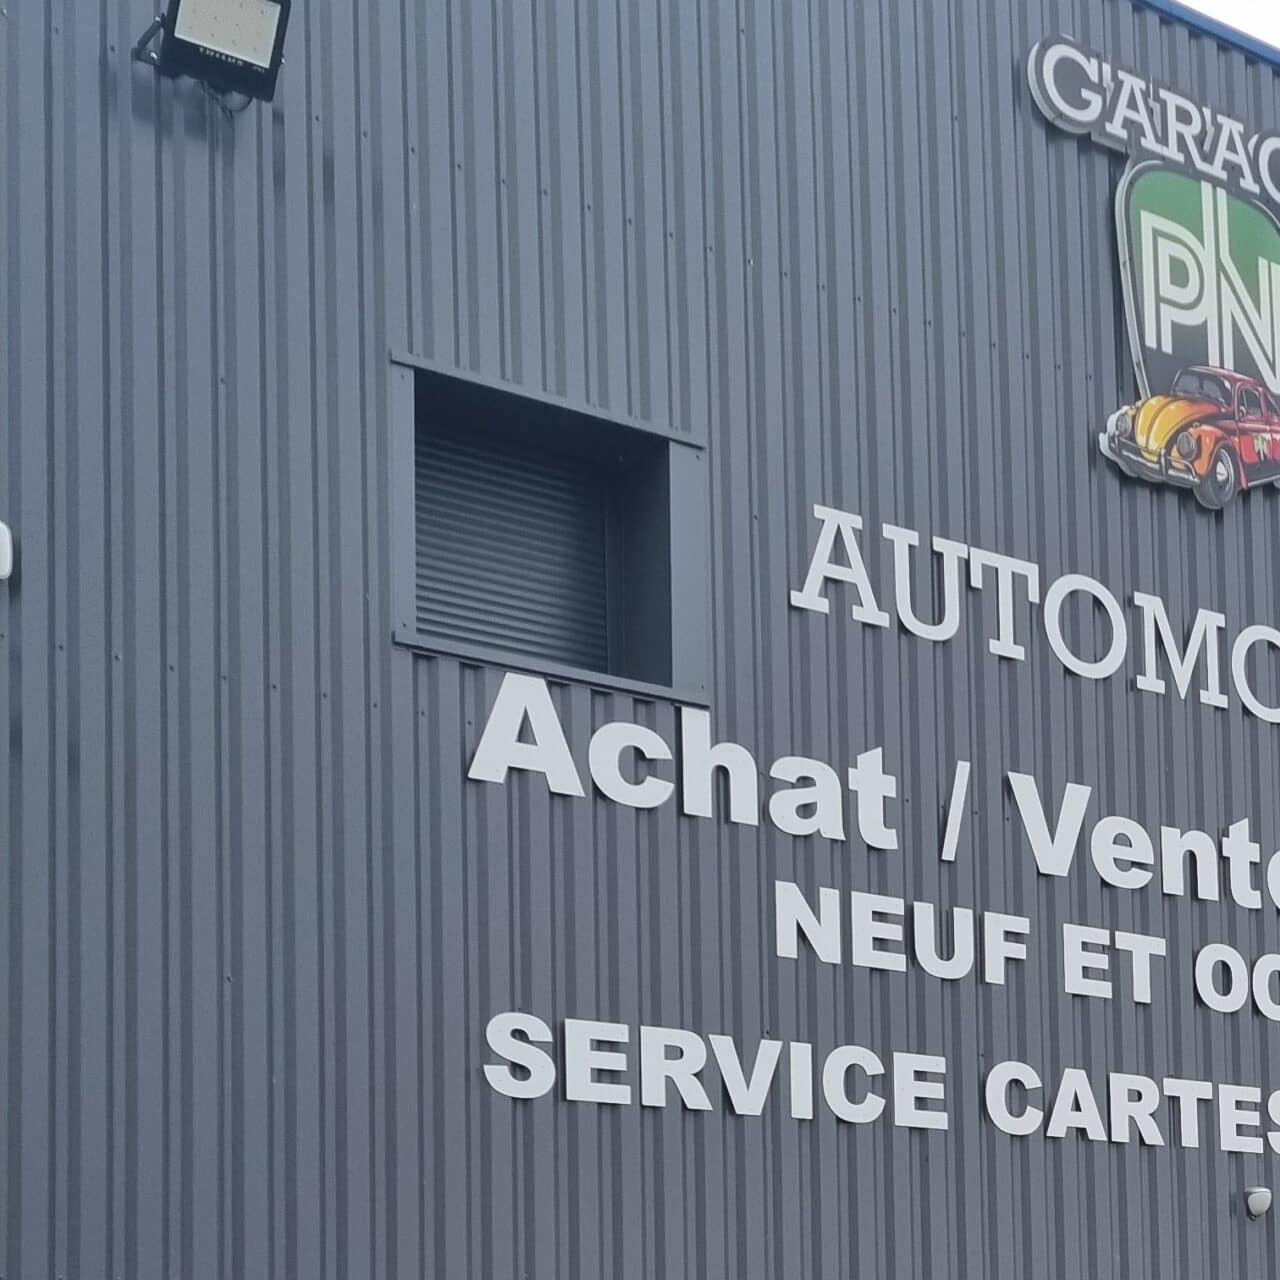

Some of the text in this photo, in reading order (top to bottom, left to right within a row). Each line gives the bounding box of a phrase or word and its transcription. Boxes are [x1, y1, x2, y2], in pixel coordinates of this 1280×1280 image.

[467, 672, 899, 850] Achat
[941, 760, 971, 862] /
[775, 880, 1030, 985] NEUF
[1062, 922, 1167, 1004] ET
[483, 1012, 949, 1130] SERVICE
